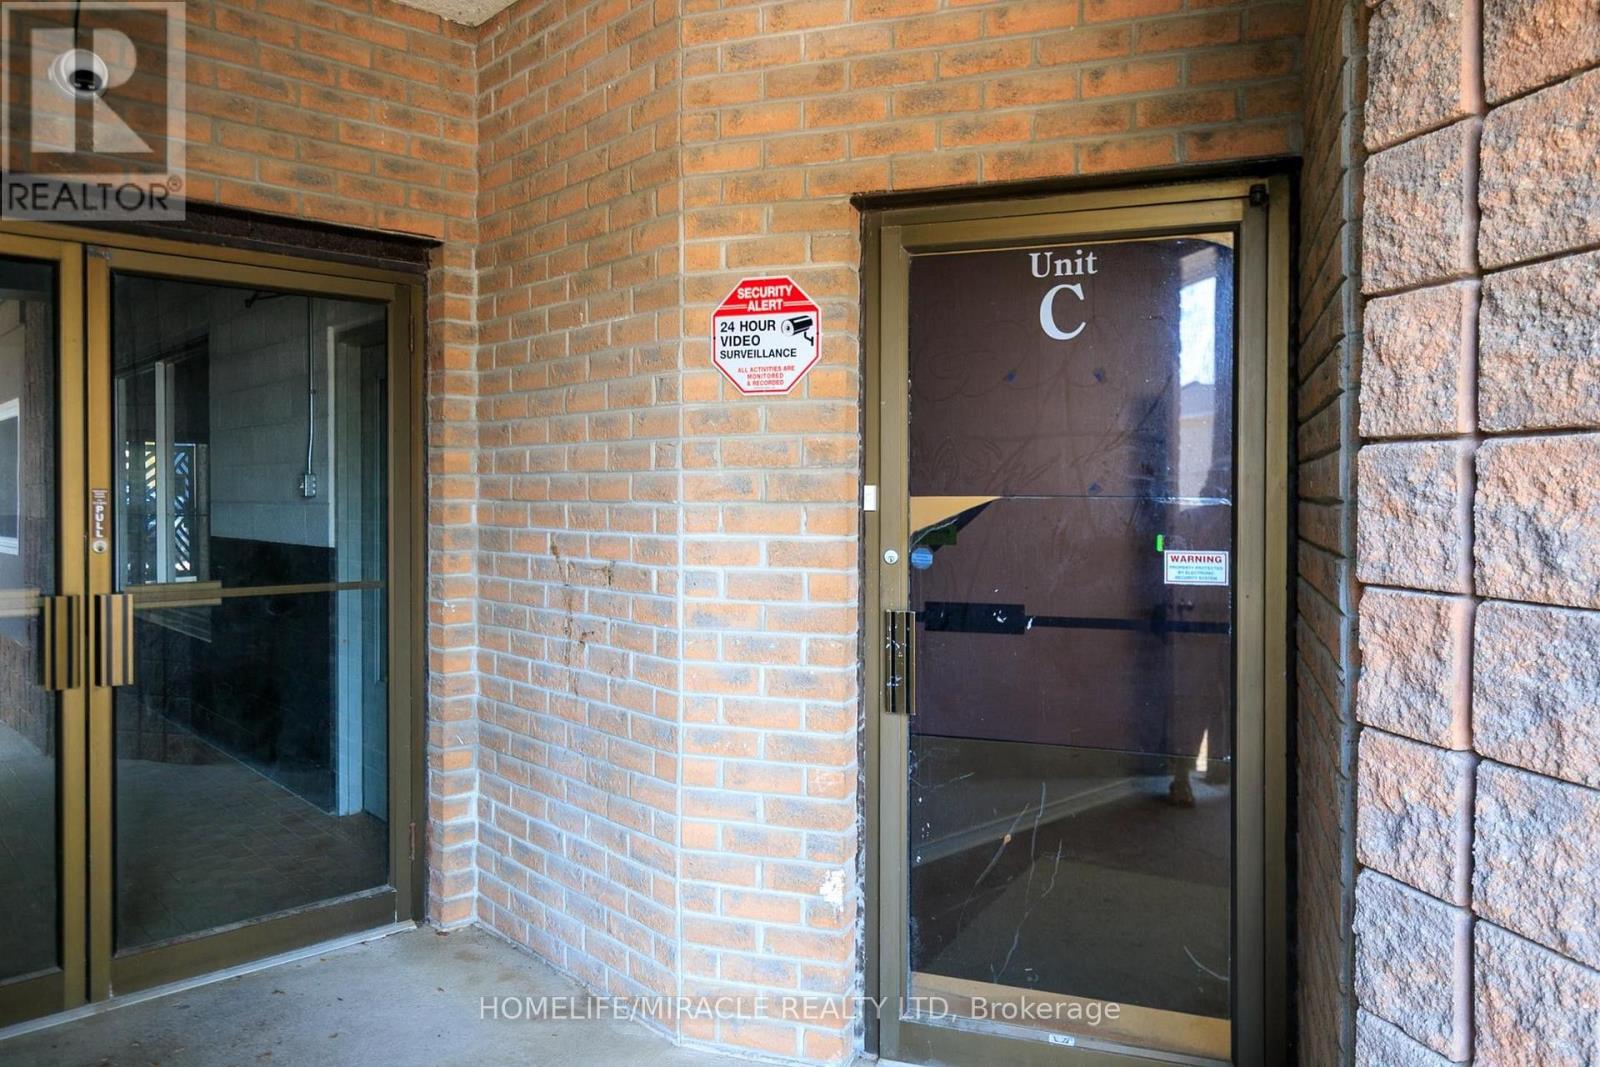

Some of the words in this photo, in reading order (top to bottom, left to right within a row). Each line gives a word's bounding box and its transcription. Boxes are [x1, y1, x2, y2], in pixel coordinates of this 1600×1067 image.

[1028, 249, 1098, 278] Unit
[737, 285, 793, 299] SECURITY
[747, 299, 783, 312] ALERT
[1039, 283, 1087, 341] C
[720, 321, 735, 332] 24
[739, 319, 776, 332] HOUR
[720, 335, 760, 347] VIDEO
[720, 348, 797, 359] SURVEILLANCE
[95, 505, 104, 538] PULL
[1170, 555, 1222, 563] WARNING
